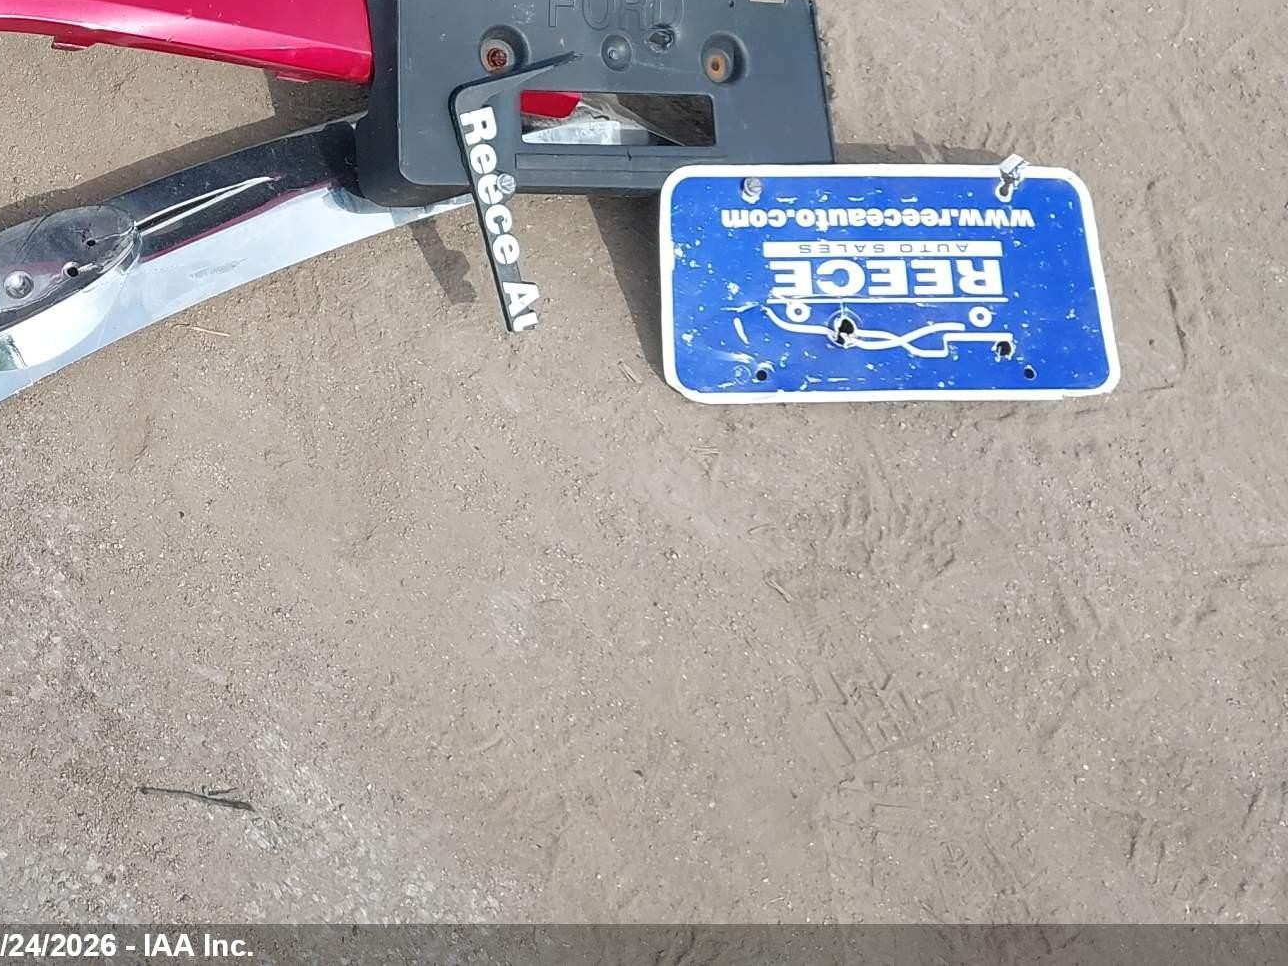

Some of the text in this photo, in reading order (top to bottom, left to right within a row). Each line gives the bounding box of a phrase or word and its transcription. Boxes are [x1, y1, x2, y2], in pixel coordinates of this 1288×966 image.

[459, 106, 520, 265] Reece
[721, 207, 1036, 231] www.reeceauto.com
[799, 243, 968, 254] AUTO SALES
[768, 257, 1003, 296] REECE
